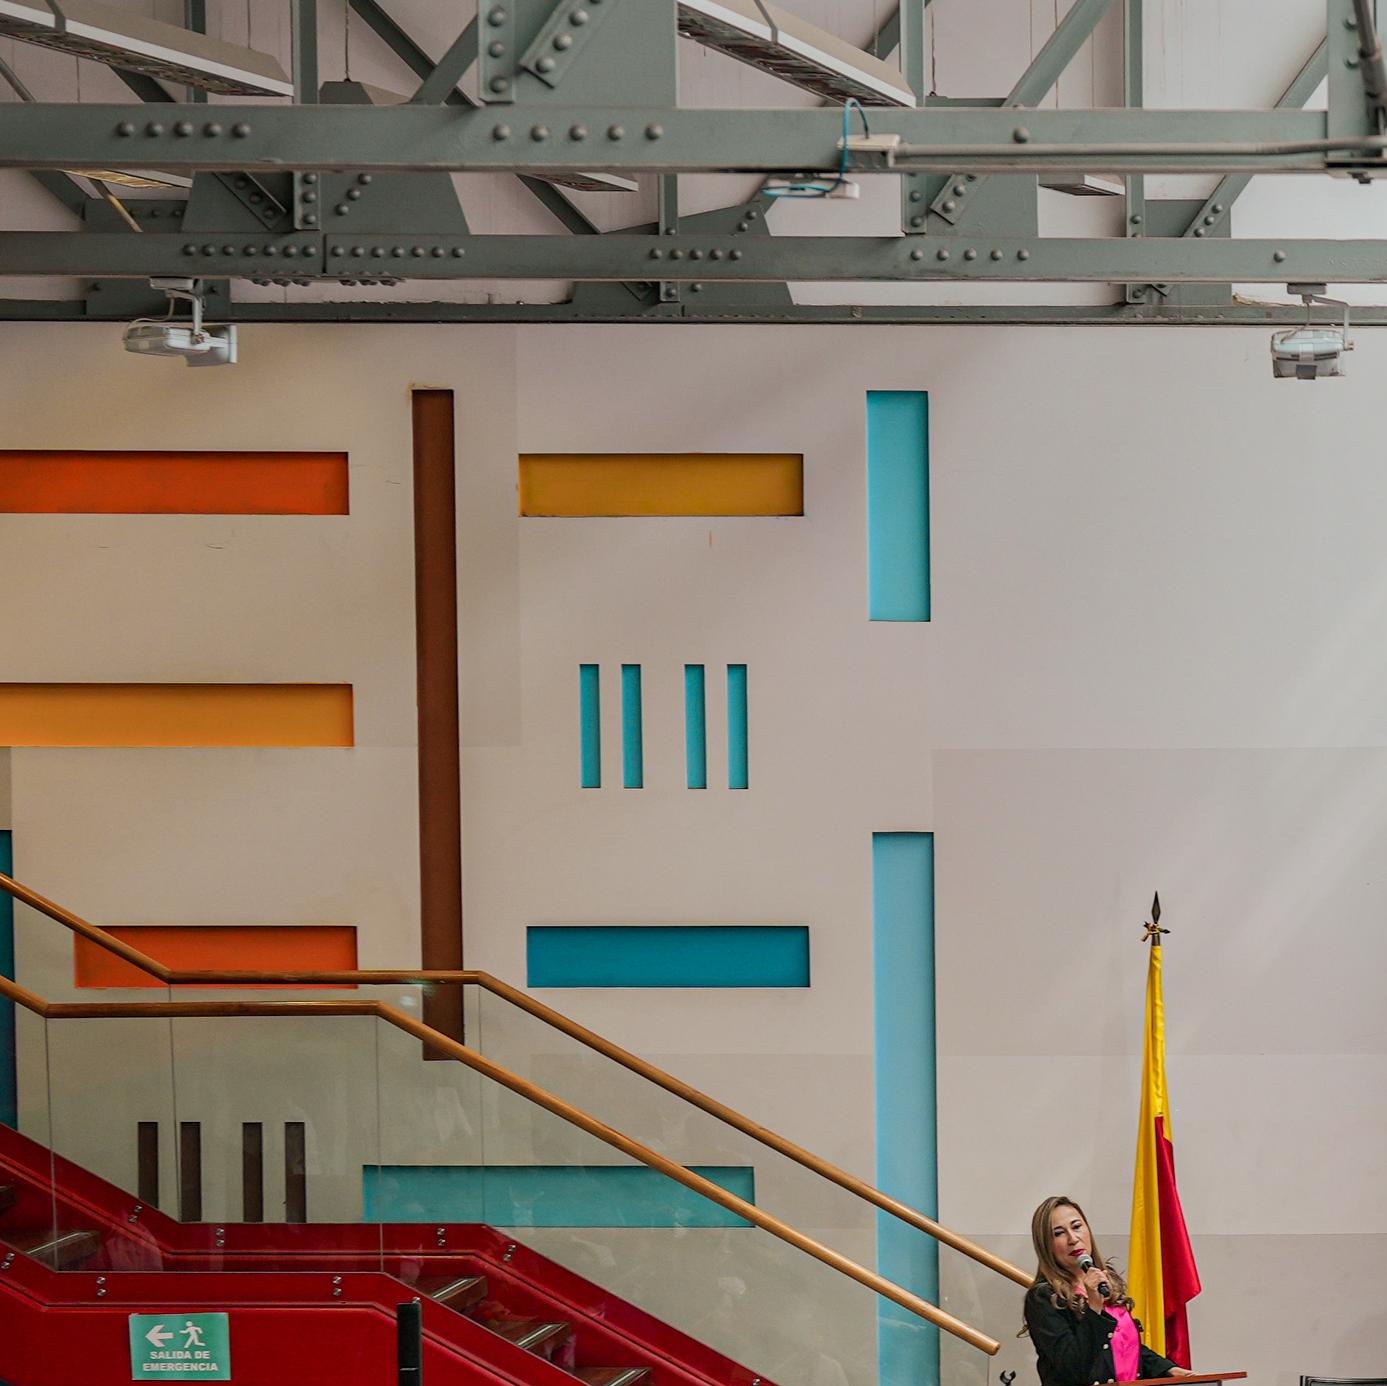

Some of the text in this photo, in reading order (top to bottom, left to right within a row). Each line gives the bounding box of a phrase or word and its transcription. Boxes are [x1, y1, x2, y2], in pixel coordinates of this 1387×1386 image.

[150, 1351, 210, 1359] SALIDA DE
[143, 1362, 218, 1371] EMERGENCIA
